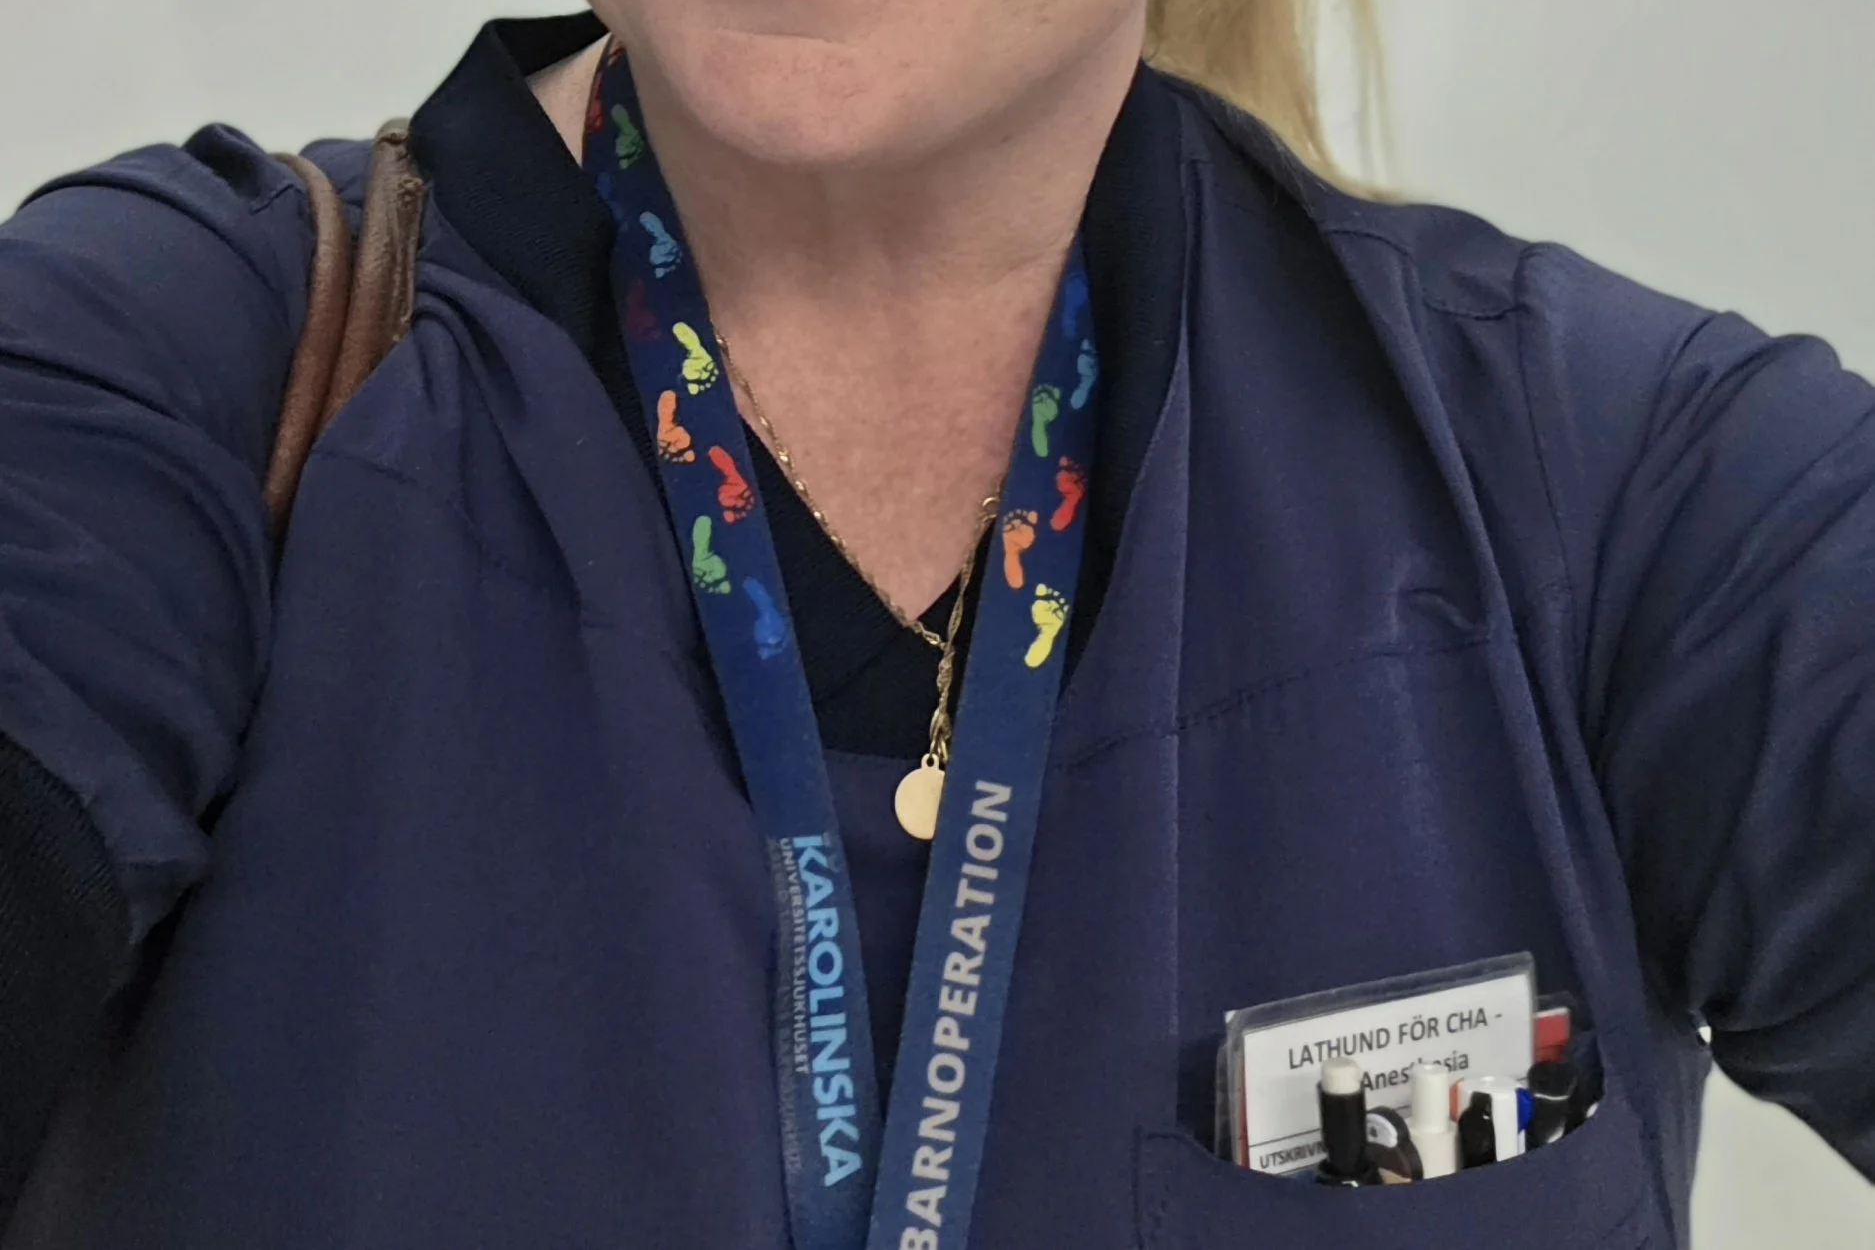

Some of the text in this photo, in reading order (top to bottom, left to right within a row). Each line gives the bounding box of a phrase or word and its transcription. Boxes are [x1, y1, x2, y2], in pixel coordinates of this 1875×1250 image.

[792, 834, 864, 1188] KAROLINSKA
[898, 779, 1013, 1250] BARNOPERATION
[1288, 1026, 1391, 1071] LATHUND
[1398, 1014, 1440, 1046] FÖR
[1446, 1007, 1488, 1034] CHA
[1361, 1050, 1469, 1092] Anessia
